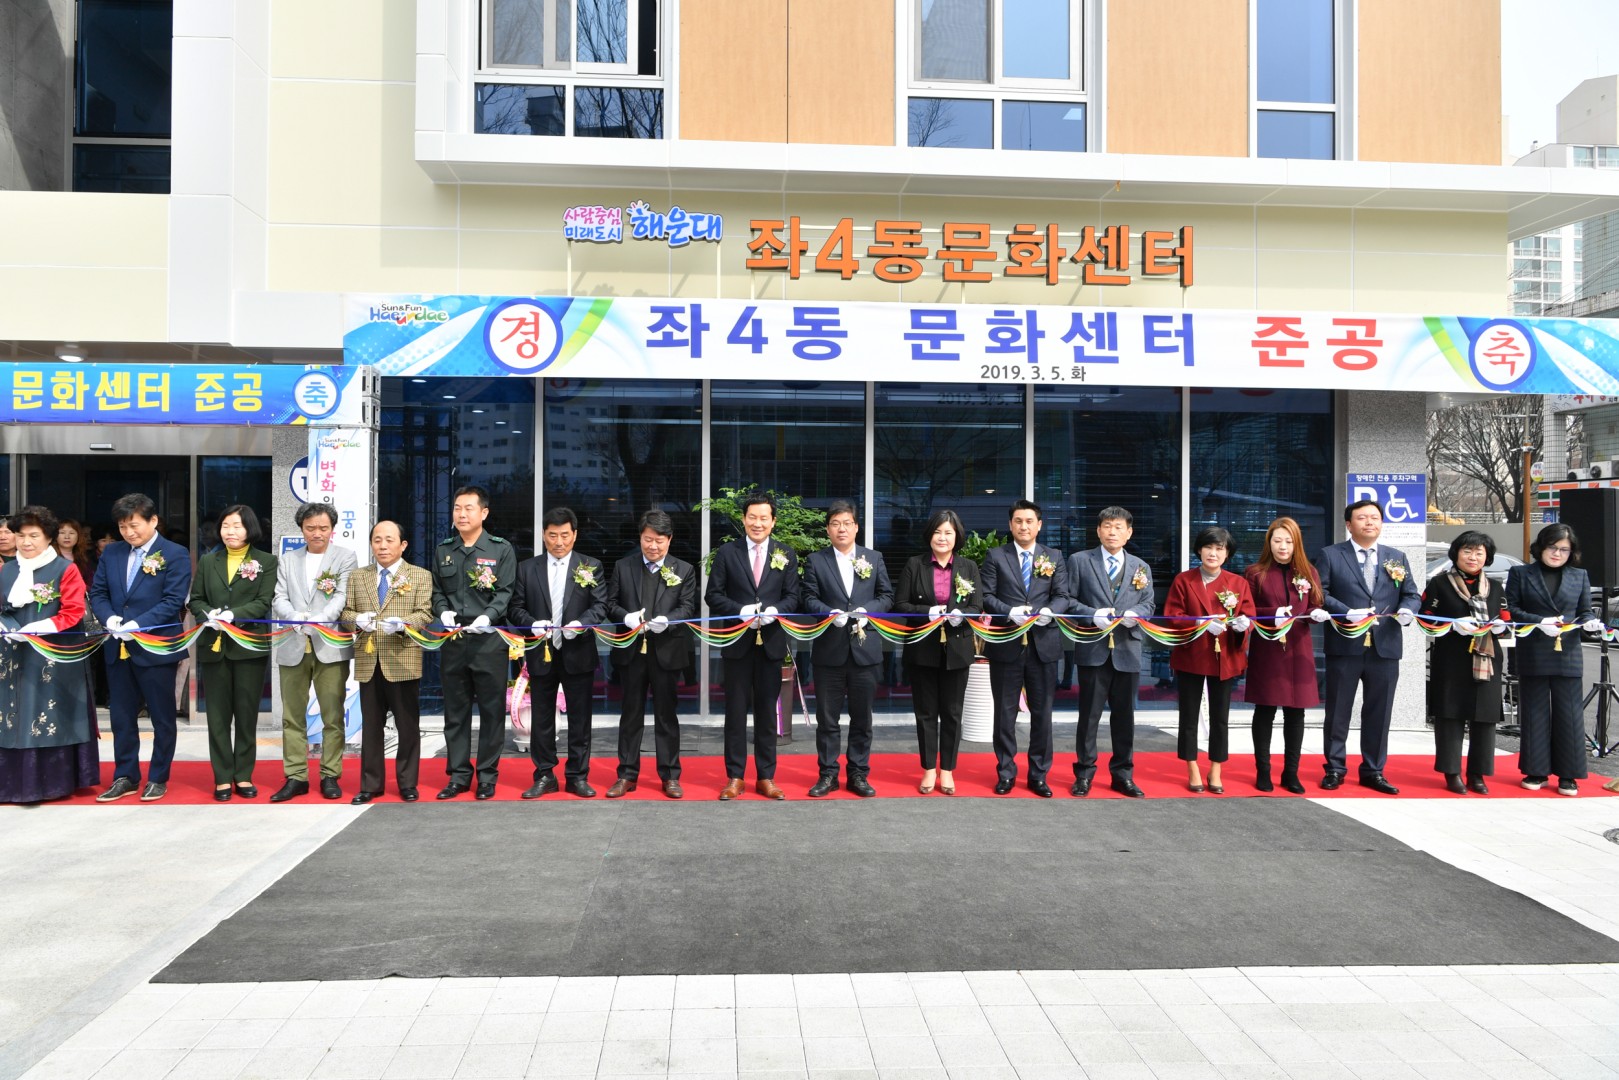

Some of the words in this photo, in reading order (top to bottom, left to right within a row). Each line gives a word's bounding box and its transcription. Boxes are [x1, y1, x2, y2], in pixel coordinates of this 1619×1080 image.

[565, 207, 621, 225] 사람중심
[565, 225, 621, 240] 미래도시
[630, 206, 721, 245] 해운대
[746, 217, 1194, 287] 좌4동문화센터
[500, 311, 540, 359] 경
[646, 304, 848, 361] 좌4동
[904, 309, 1194, 366] 문화센터
[1251, 316, 1383, 371] 준공
[1482, 330, 1525, 377] 축
[12, 371, 170, 412] 문화센터
[195, 373, 262, 412] 준공
[303, 381, 328, 407] 축
[1071, 366, 1087, 382] 화
